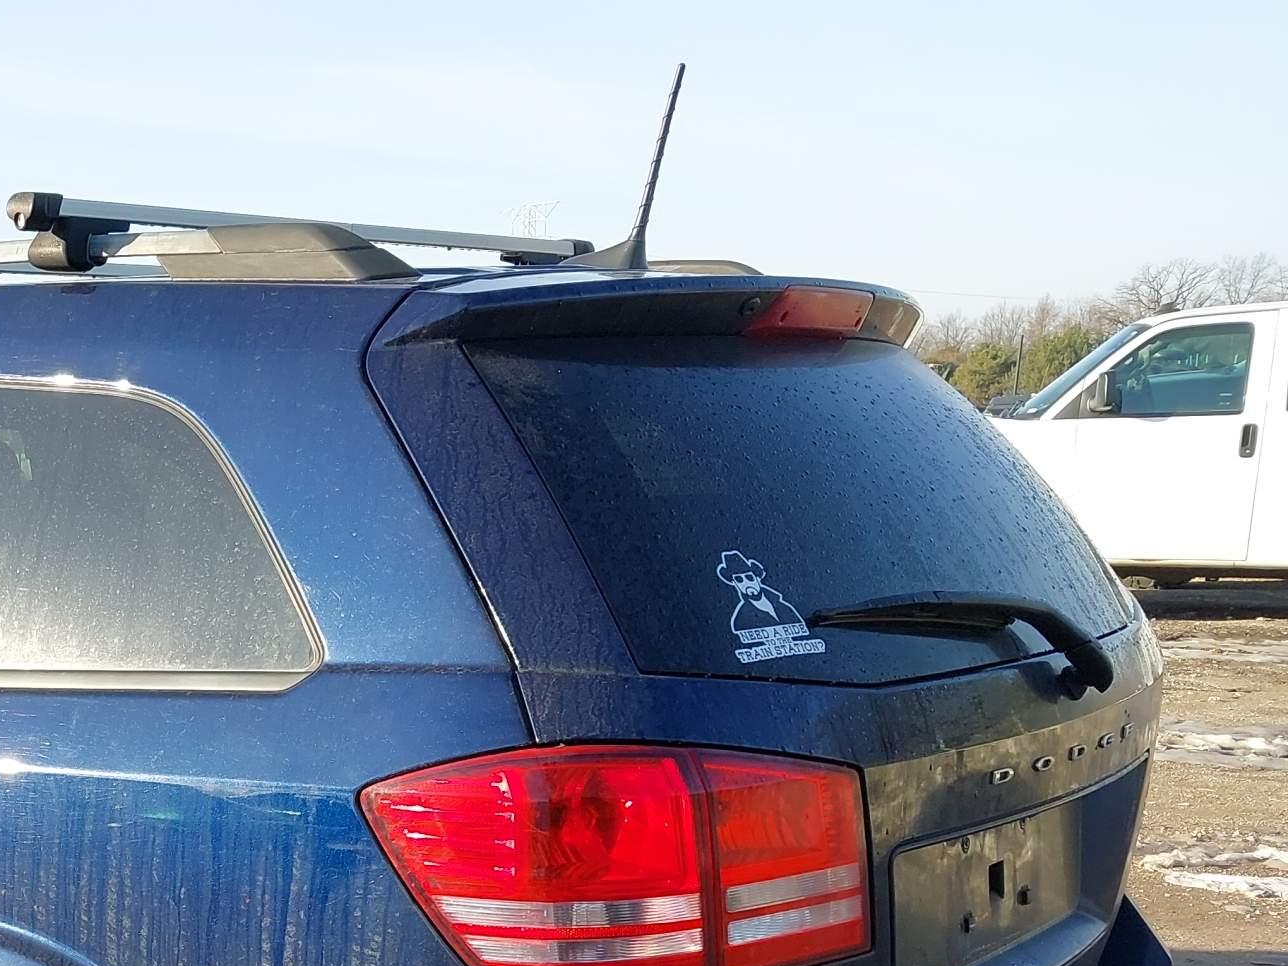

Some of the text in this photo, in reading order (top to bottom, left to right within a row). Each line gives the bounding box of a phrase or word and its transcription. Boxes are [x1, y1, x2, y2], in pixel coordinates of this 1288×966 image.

[740, 624, 807, 642] NEED A RIDE
[766, 637, 792, 646] TO THE
[738, 641, 824, 662] TRAIN STATION?
[990, 722, 1136, 785] DODGE
